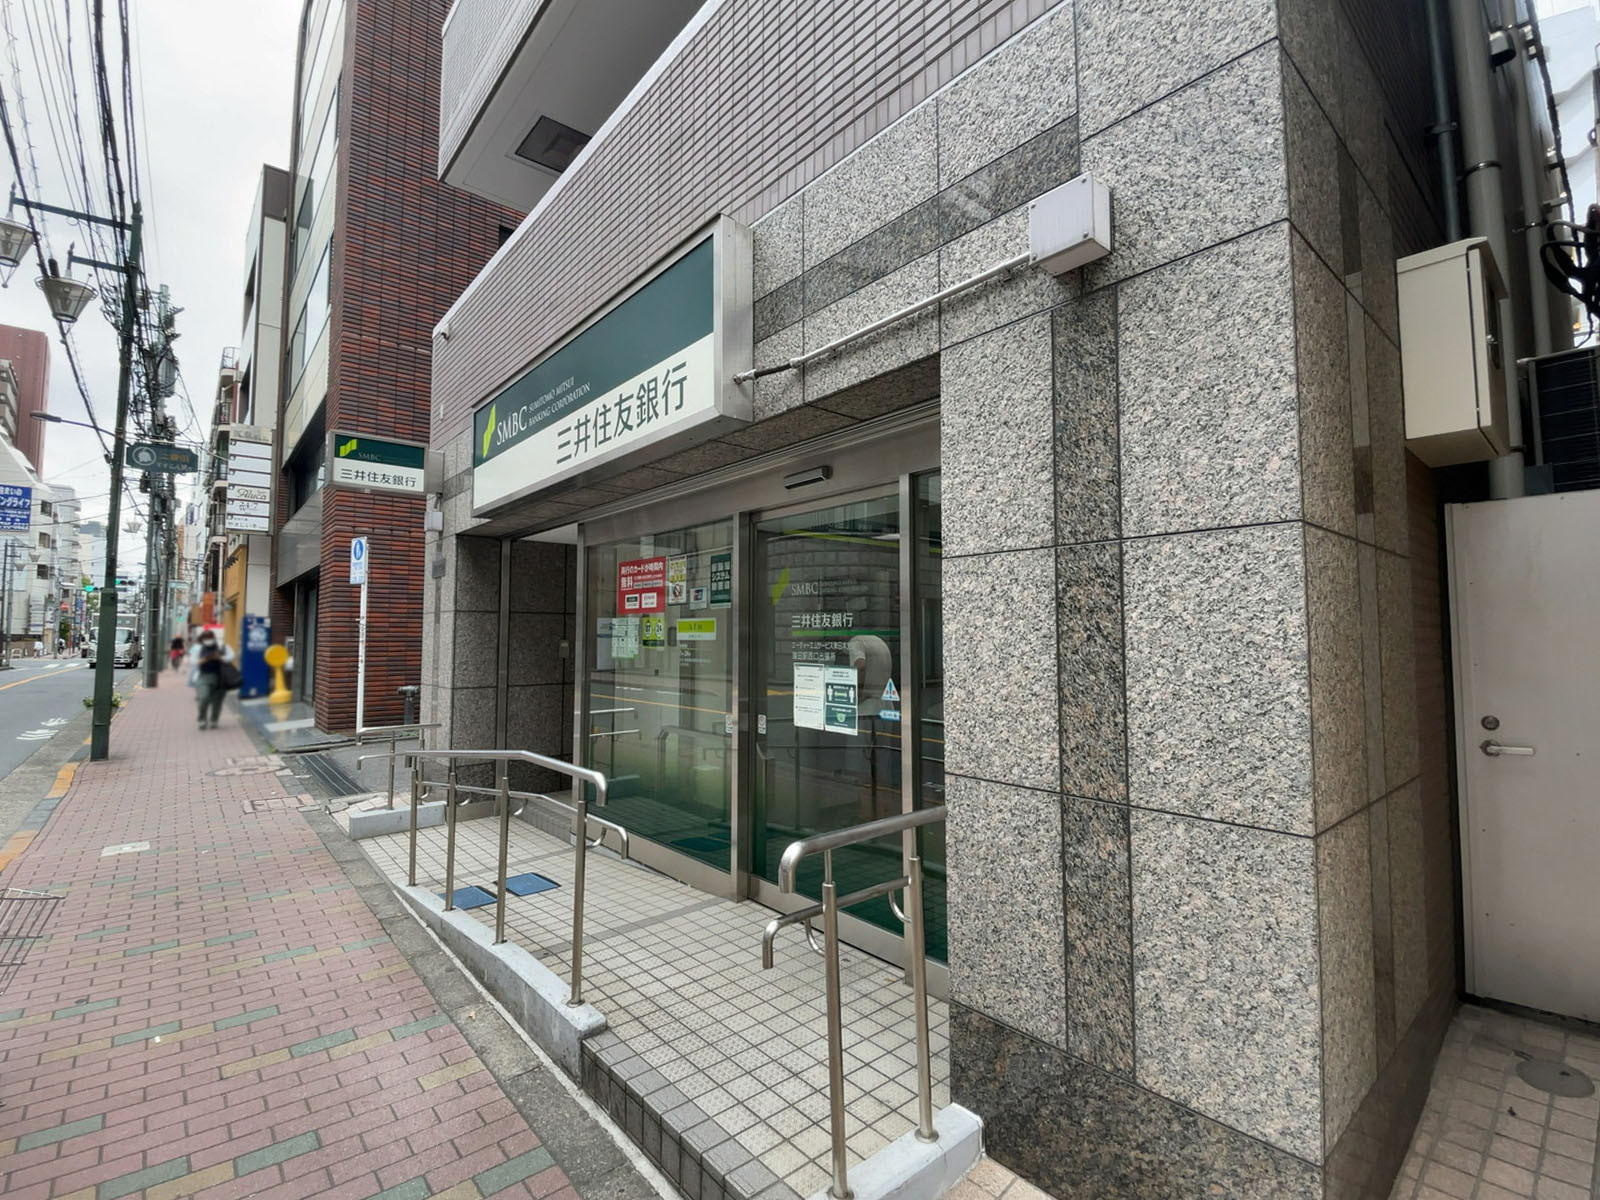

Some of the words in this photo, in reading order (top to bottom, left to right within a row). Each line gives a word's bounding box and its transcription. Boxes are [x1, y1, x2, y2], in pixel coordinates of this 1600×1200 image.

[528, 389, 556, 414] SUMITOMO
[556, 376, 575, 397] MITSUI
[528, 405, 551, 427] BANKING
[551, 382, 591, 413] CORPORATION
[556, 361, 688, 464] 三井住友銀行
[496, 405, 528, 446] SMBC
[340, 467, 417, 488] 三井住友銀行
[791, 582, 819, 596] SMBC
[792, 613, 854, 628] 三井住友銀行
